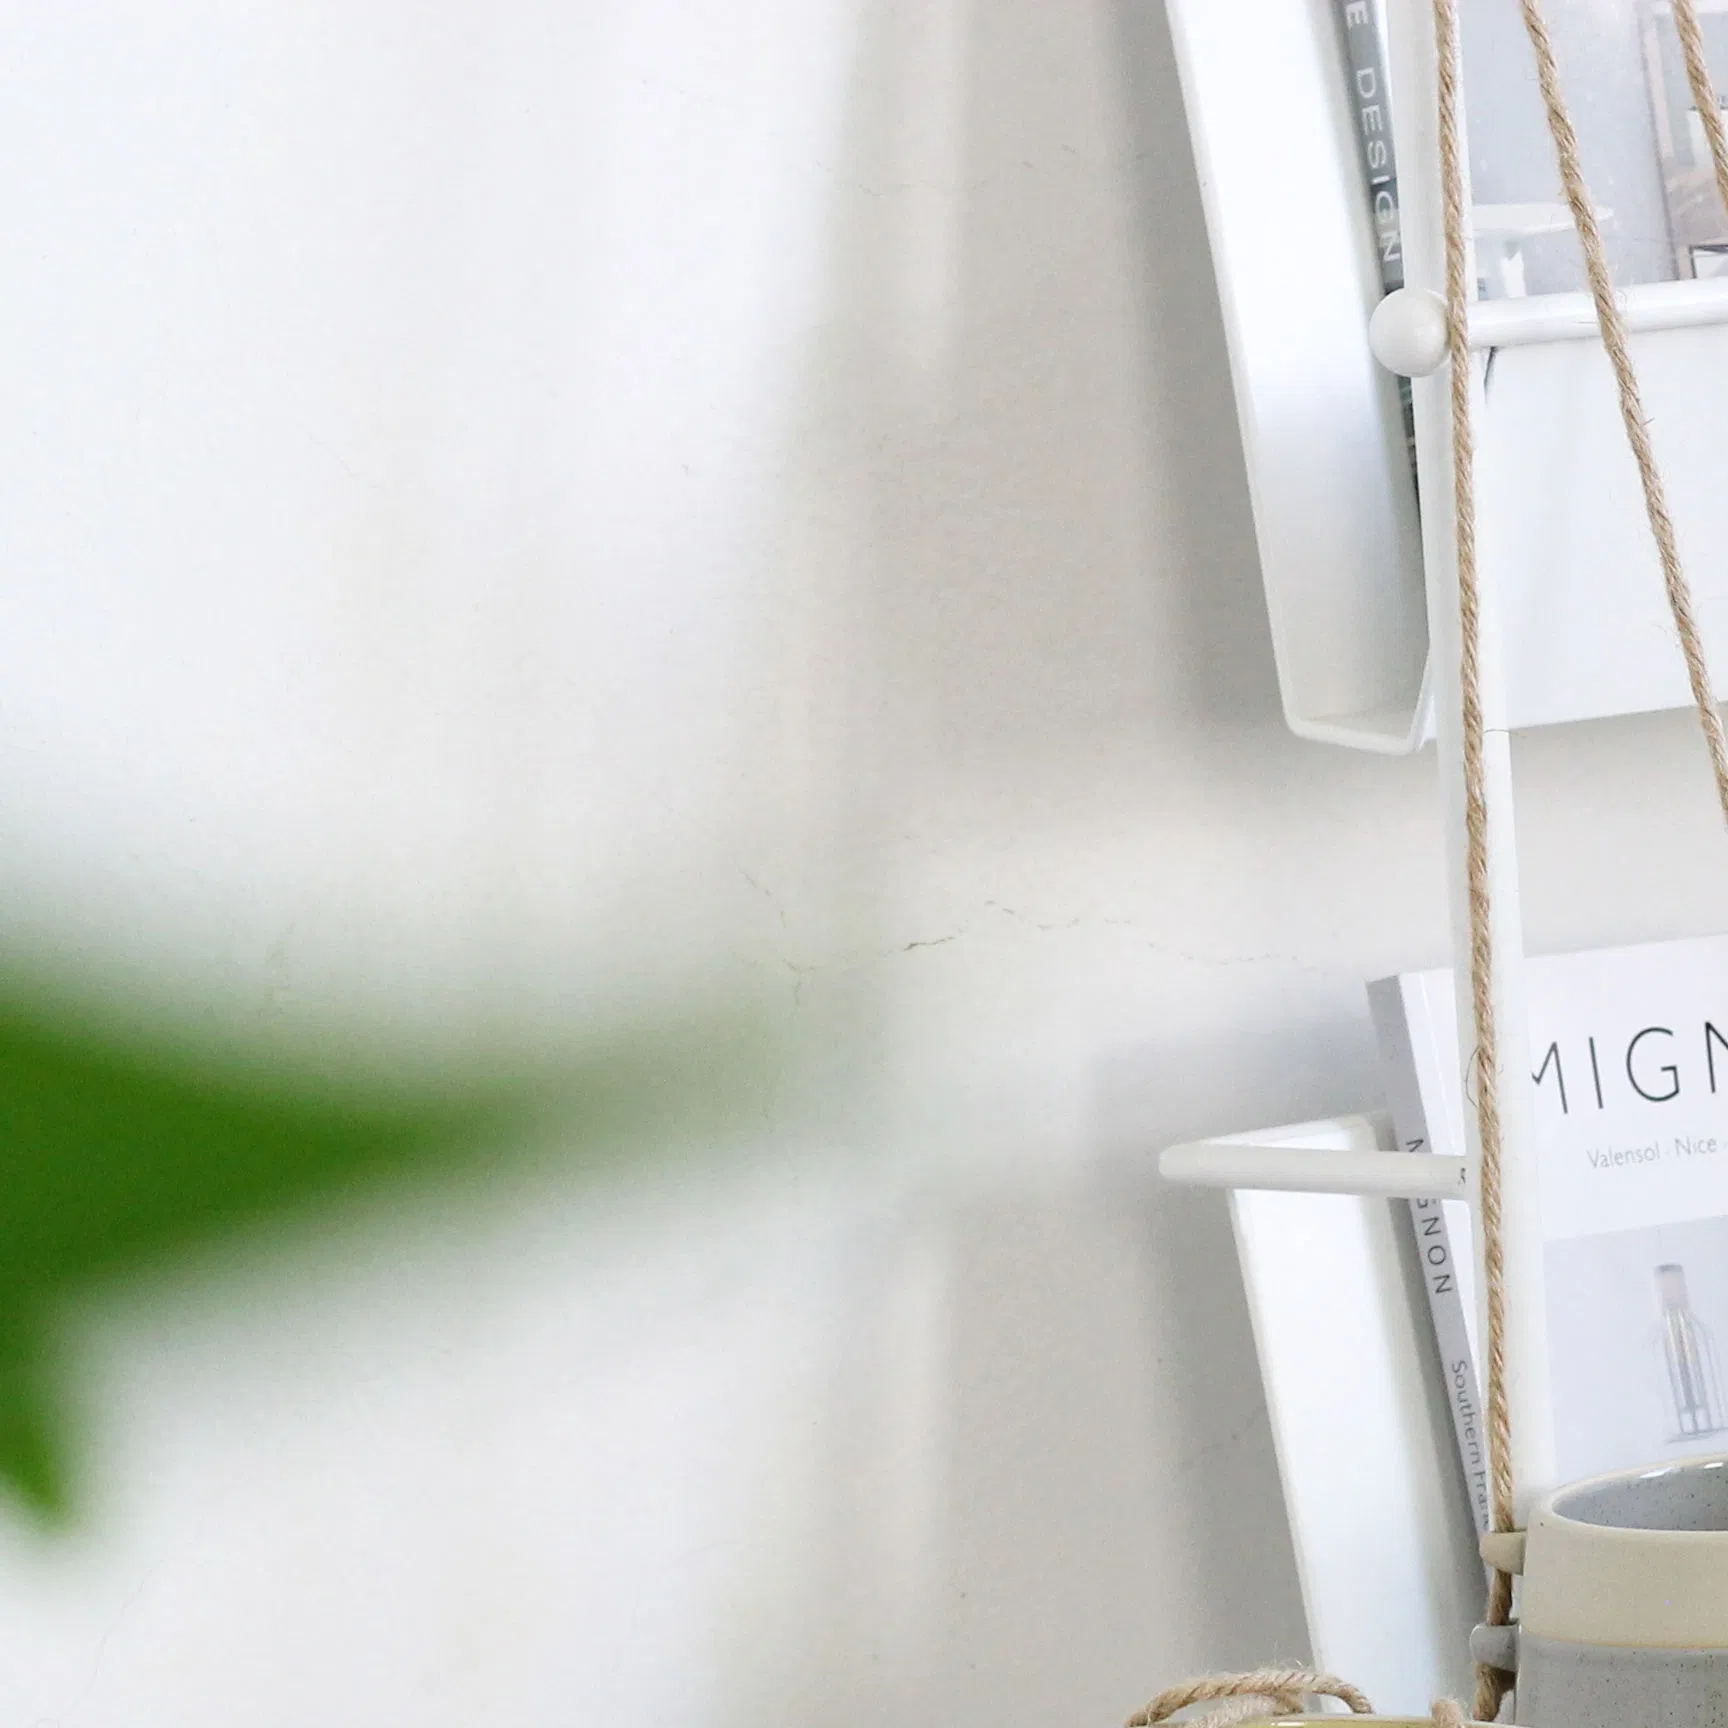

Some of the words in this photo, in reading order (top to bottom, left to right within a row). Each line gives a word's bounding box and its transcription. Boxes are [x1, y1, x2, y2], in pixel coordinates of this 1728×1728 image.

[1356, 67, 1401, 263] DESIGN
[1586, 1140, 1661, 1169] Valensol
[1674, 1135, 1718, 1158] Nice
[1451, 1360, 1486, 1465] Southern
